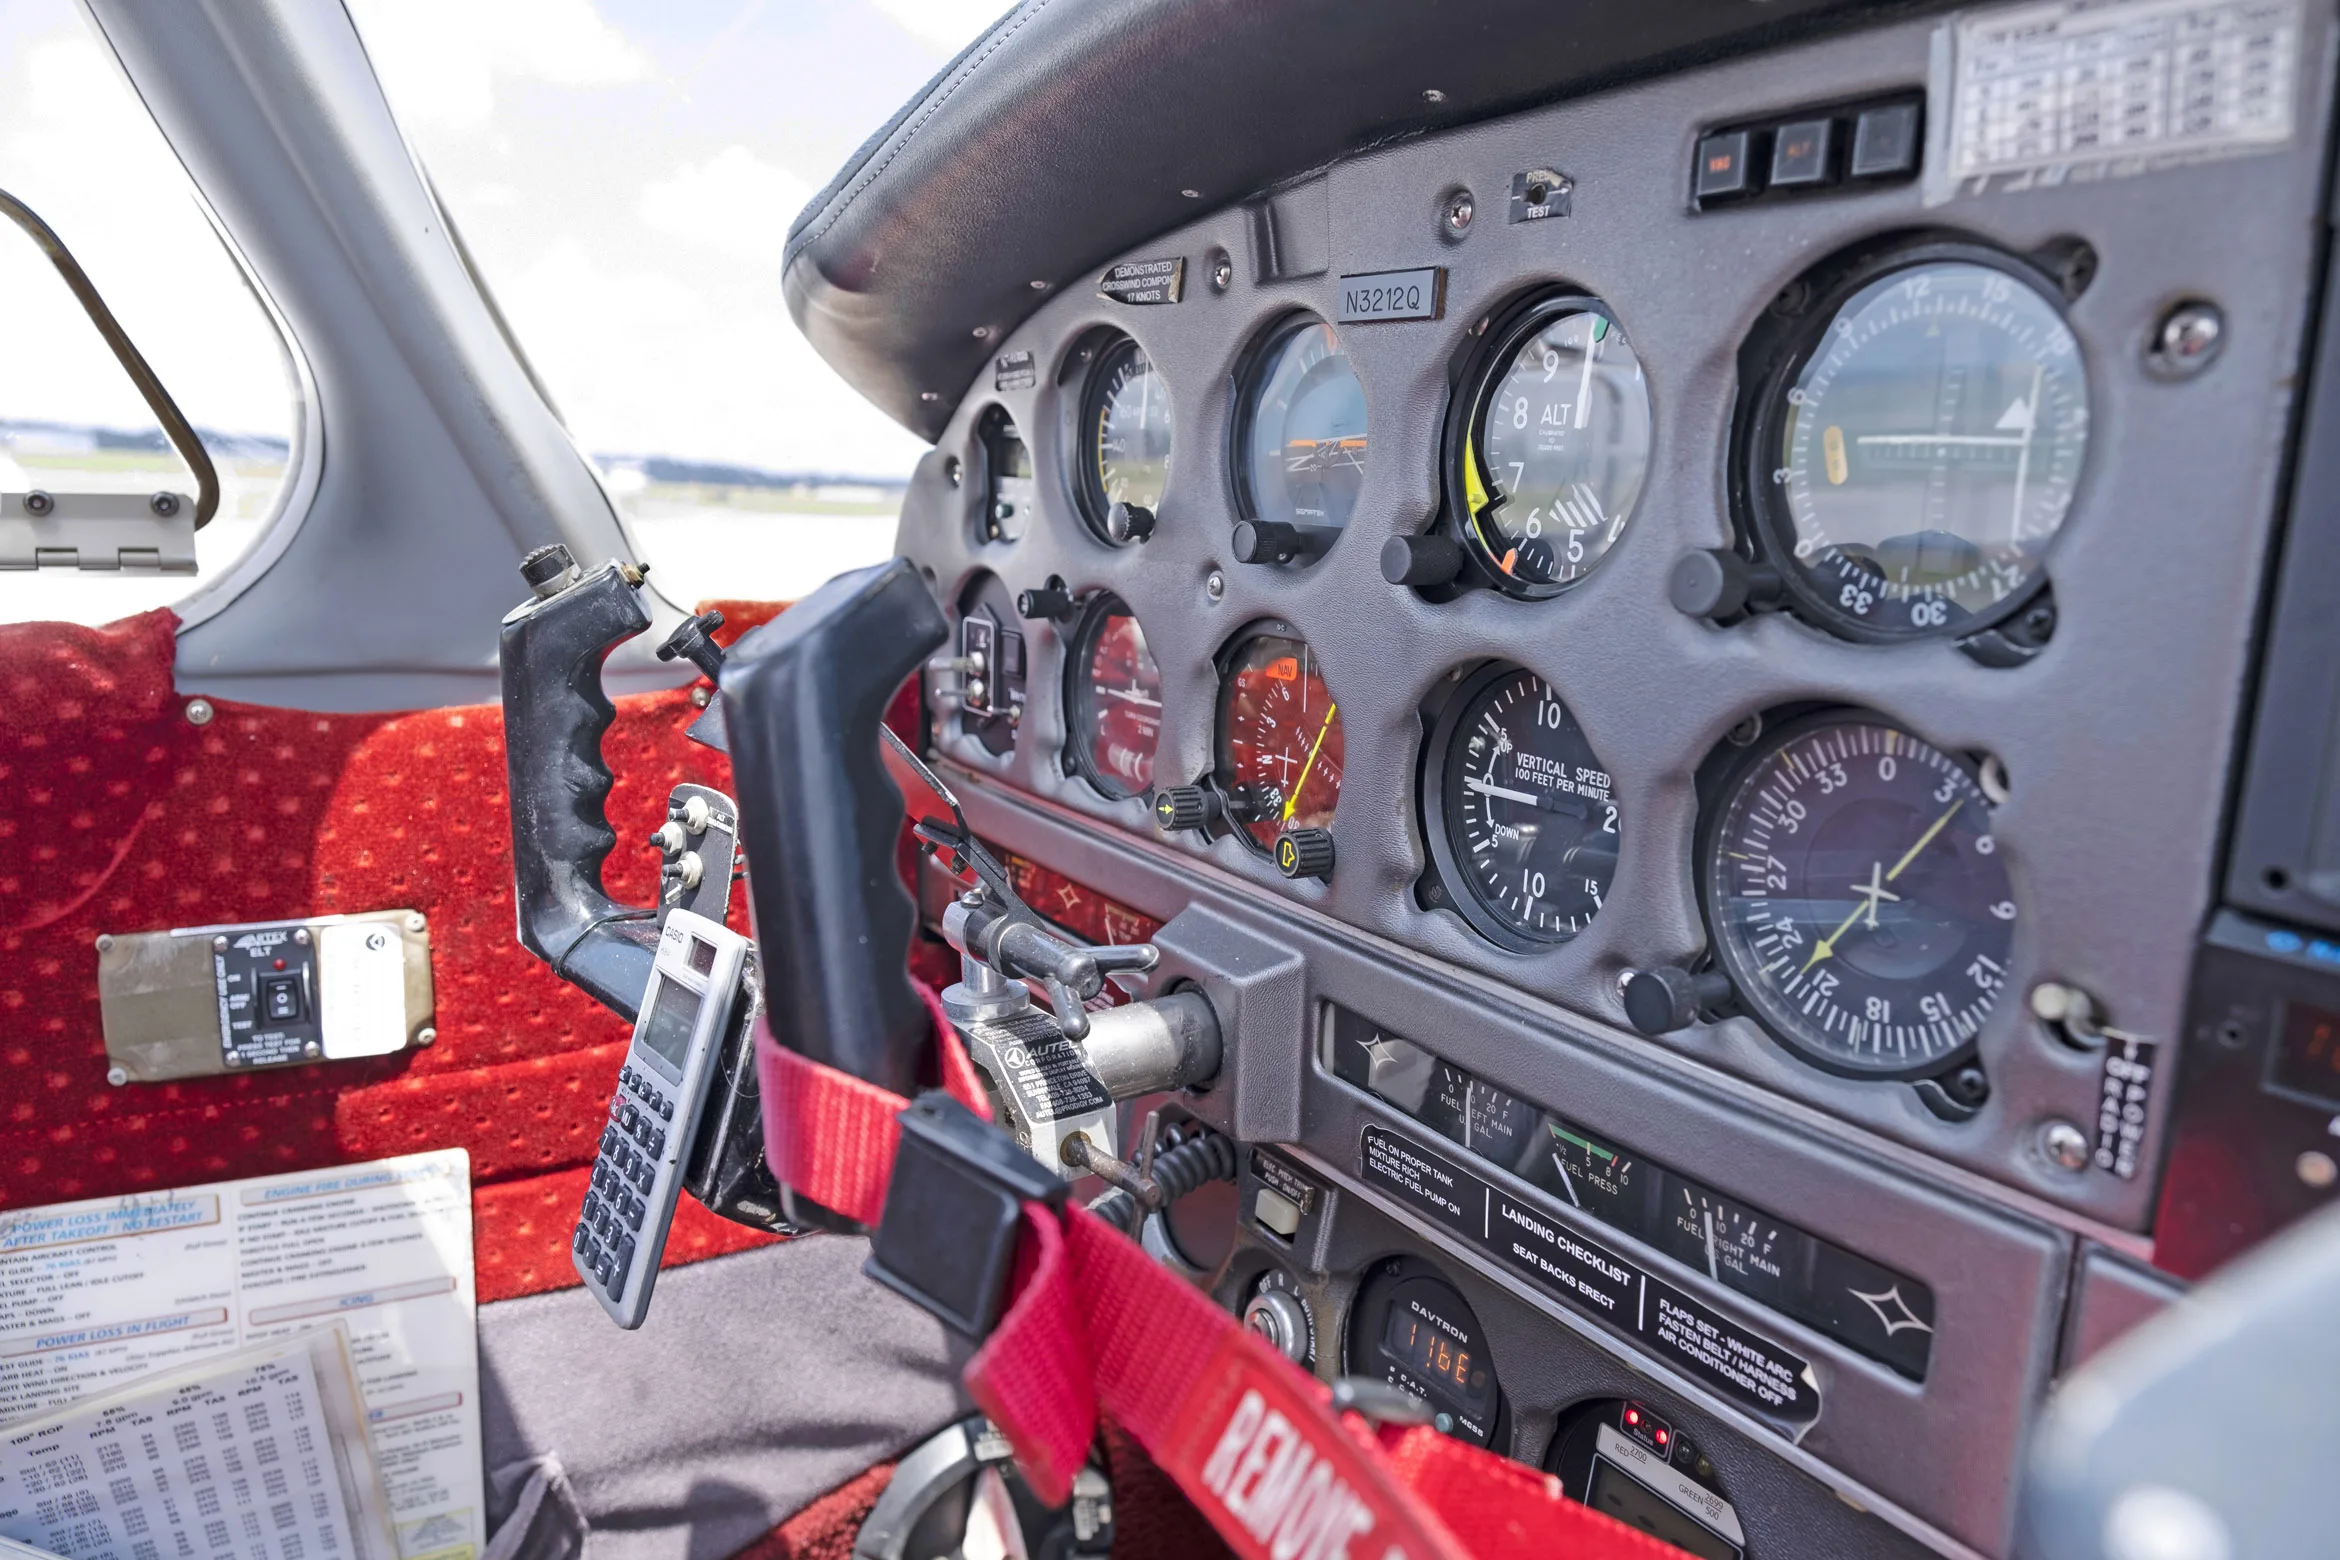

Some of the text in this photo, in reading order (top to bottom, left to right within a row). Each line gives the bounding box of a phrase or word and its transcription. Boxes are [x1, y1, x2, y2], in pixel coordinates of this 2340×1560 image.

[1527, 205, 1551, 218] TEST
[1114, 261, 1172, 278] DEMONSTRATED
[1103, 279, 1141, 292] CROSSWIND
[1127, 290, 1160, 302] 17 KNOTS
[1904, 275, 1931, 300] 12
[1982, 277, 2011, 301] 15
[1346, 285, 1421, 314] N3212Q
[1834, 316, 1853, 338] 9
[1543, 350, 1559, 383] 9
[1787, 387, 1807, 406] 6
[1513, 397, 1529, 429] 8
[1540, 404, 1572, 425] ALT
[1508, 462, 1525, 493] 7
[1774, 467, 1793, 485] 3
[1525, 507, 1542, 539] 6
[1567, 529, 1584, 563] 5
[1839, 584, 1874, 614] 33
[1911, 601, 1947, 627] 30
[1277, 664, 1293, 678] NAV
[1281, 687, 1291, 702] 6
[1266, 717, 1277, 729] 3
[1537, 700, 1561, 729] 10
[1500, 728, 1508, 741] 5
[1500, 742, 1513, 754] UP
[1262, 754, 1273, 766] N
[1517, 752, 1611, 788] VERTICAL SPEED
[1879, 757, 1896, 780] 0
[1515, 768, 1610, 802] 100 FEET PER MINUTE
[1814, 763, 1848, 794] 33
[1933, 778, 1957, 802] 3
[1270, 787, 1283, 808] 33
[1778, 800, 1807, 833] 30
[1491, 834, 1498, 848] 5
[1494, 823, 1519, 840] DOWN
[1523, 869, 1545, 898] 10
[1585, 878, 1598, 895] 15
[1767, 856, 1787, 890] 27
[666, 926, 684, 943] CASIO
[1776, 916, 1803, 949] 24
[250, 946, 272, 958] ELT
[1811, 968, 1840, 997] 21
[1966, 954, 2001, 989] 12
[1866, 997, 1890, 1023] 18
[1920, 992, 1952, 1022] 15
[232, 1021, 252, 1030] TEST
[1026, 1040, 1077, 1059] AUTEL
[1063, 1080, 1072, 1088] CA
[1069, 1069, 1088, 1079] DRIVE
[1035, 1096, 1104, 1119] AUTEL@PRODIGY.COM
[1441, 1093, 1513, 1137] FUEL EFT MAIN
[1448, 1084, 1509, 1119] 0 20 F
[1474, 1122, 1493, 1139] GAL.
[601, 1133, 632, 1170] 7 8 9
[1368, 1136, 1453, 1188] FUEL ON PROPER TANK
[1369, 1146, 1420, 1182] MIXTURE RICH
[1263, 1160, 1293, 1183] ELEC PITCH
[1264, 1172, 1279, 1186] PUSH
[1561, 1159, 1618, 1195] FUEL PRESS
[1585, 1156, 1629, 1186] 5 8 10
[264, 1172, 393, 1200] ENGINE FIRE DURING
[591, 1166, 622, 1205] 4 5 6
[1369, 1159, 1460, 1216] ELECTRIC FUEL PUMP ON
[3, 1212, 203, 1249] AFTER TAKEOFF NO RESTART
[12, 1201, 196, 1234] POWER LOSS IMMEDIATELY
[584, 1201, 612, 1238] 1 2 3
[1689, 1207, 1772, 1255] 0 10 20 F
[574, 1235, 580, 1248] 0
[1502, 1204, 1631, 1286] LANDING CHECKLIST
[1677, 1216, 1780, 1278] FUEL RIGHT MAIN
[1258, 1275, 1271, 1293] OFF
[1513, 1243, 1615, 1310] SEAT BACKS ERECT
[1294, 1286, 1299, 1296] L
[36, 1316, 190, 1349] POWER LOSS IN FLIGHT
[1411, 1300, 1469, 1344] DAVTRON
[1660, 1298, 1793, 1384] FLAPS SET WHITE ARC
[1657, 1327, 1783, 1407] AIR CONDITIONER OFF
[1659, 1312, 1797, 1401] FASTEN BELT HARNESS
[38, 1424, 64, 1438] ROP
[89, 1426, 116, 1440] RPM
[166, 1404, 192, 1417] RPM
[27, 1443, 61, 1457] Temp
[1633, 1427, 1654, 1446] Status
[1615, 1443, 1647, 1462] RED 2700
[1201, 1389, 1376, 1560] REMOVE
[1678, 1483, 1724, 1510] GREEN 2699
[1705, 1506, 1720, 1521] 500
